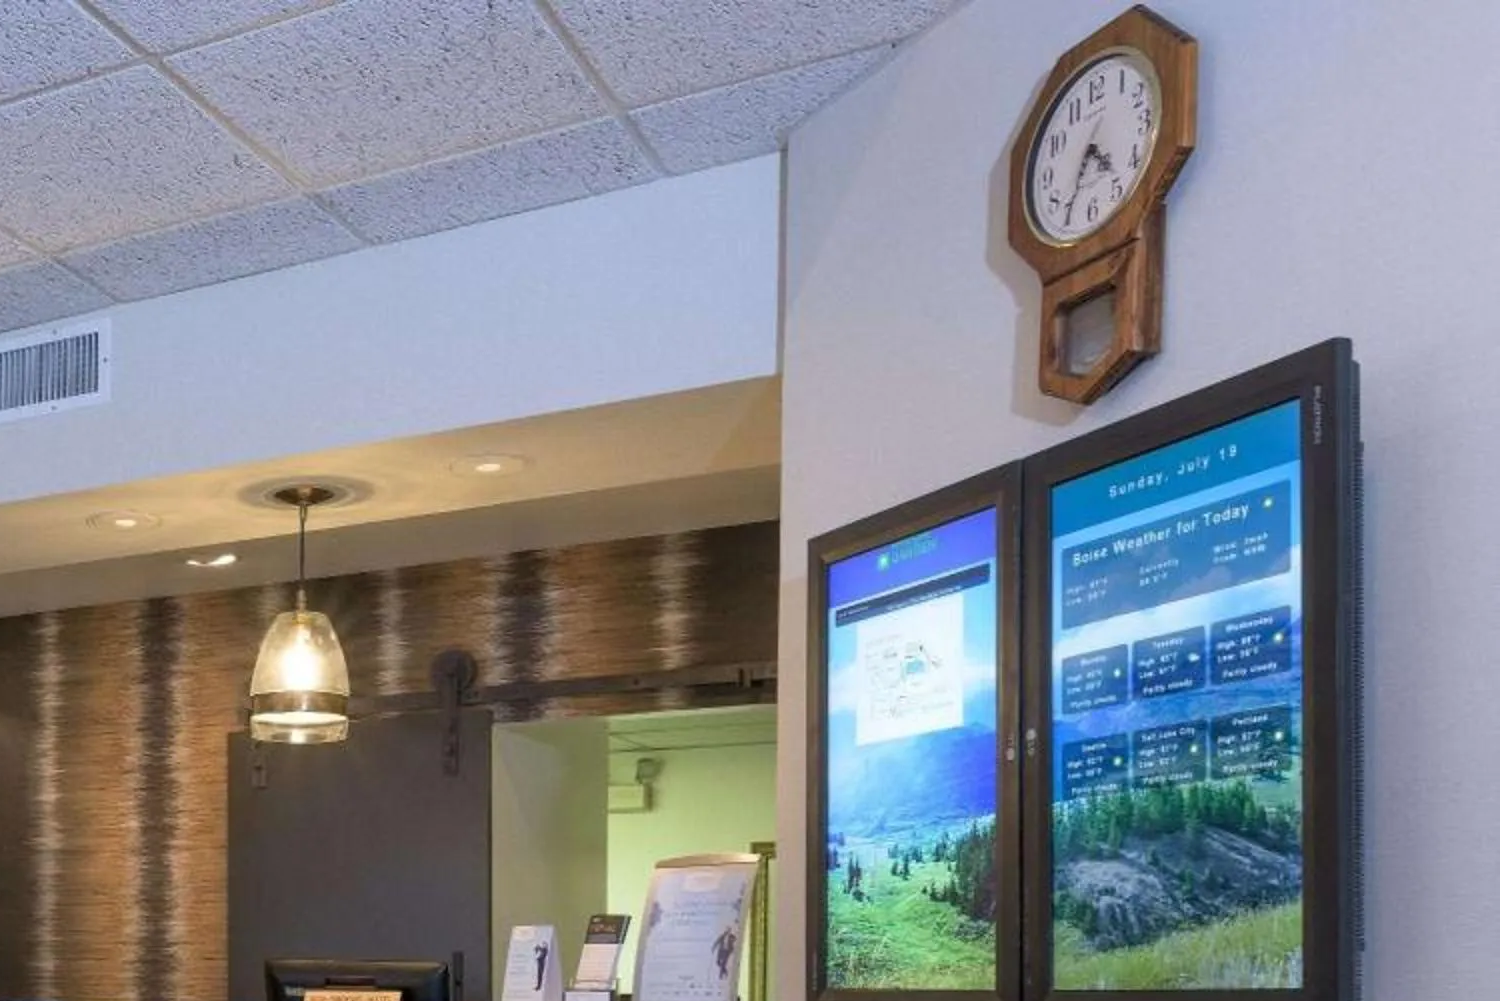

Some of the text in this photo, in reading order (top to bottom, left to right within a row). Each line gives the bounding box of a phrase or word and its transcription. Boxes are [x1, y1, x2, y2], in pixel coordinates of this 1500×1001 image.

[1089, 75, 1105, 104] 12
[1119, 69, 1125, 95] 1
[1132, 82, 1143, 108] 2
[1069, 98, 1081, 126] 11
[1138, 109, 1150, 135] 3
[1051, 130, 1067, 157] 10
[1128, 144, 1140, 169] 4
[1043, 168, 1053, 190] 9
[1110, 177, 1122, 201] 5
[1048, 189, 1060, 214] 8
[1087, 198, 1098, 222] 6
[1108, 471, 1168, 498] Sunday,
[1177, 456, 1210, 475] July
[1073, 504, 1249, 567] Boise Weather for Today
